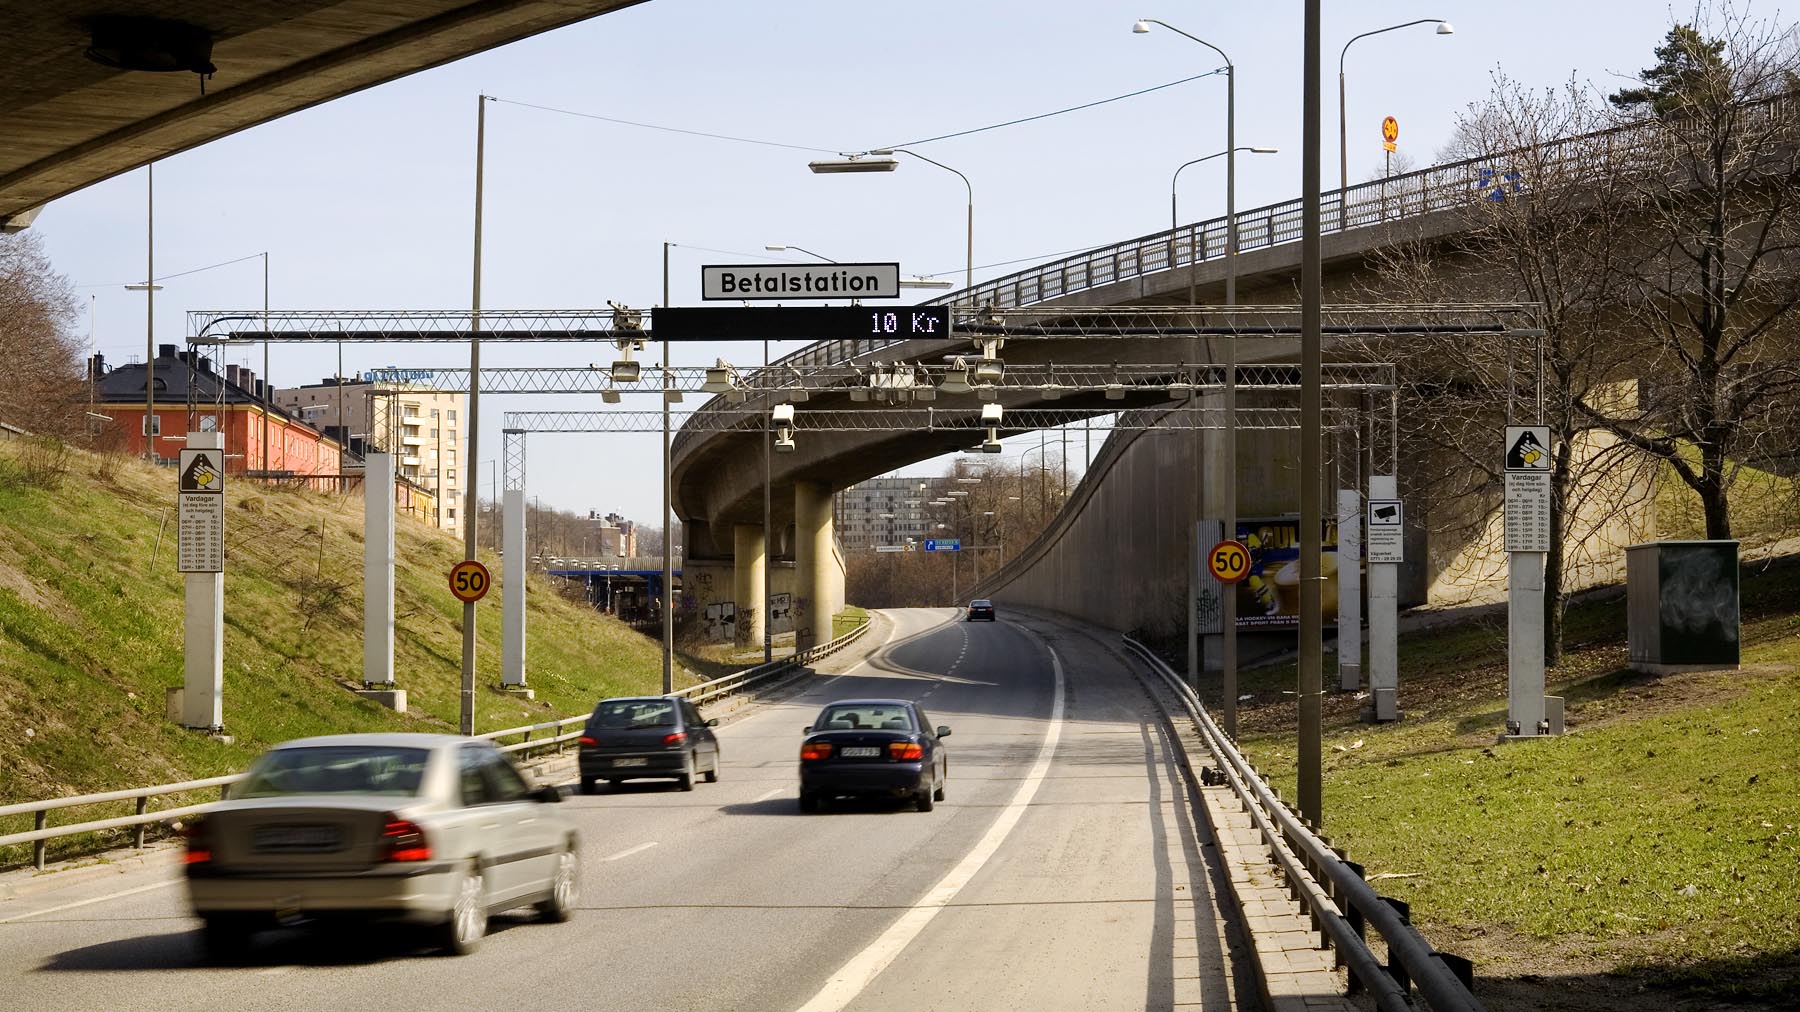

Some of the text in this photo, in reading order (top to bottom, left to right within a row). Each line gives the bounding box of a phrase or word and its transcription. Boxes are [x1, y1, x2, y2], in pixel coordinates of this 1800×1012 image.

[721, 271, 879, 293] Betalstation
[872, 313, 939, 332] 10 Kr
[1216, 552, 1244, 572] 50
[456, 572, 484, 592] 50
